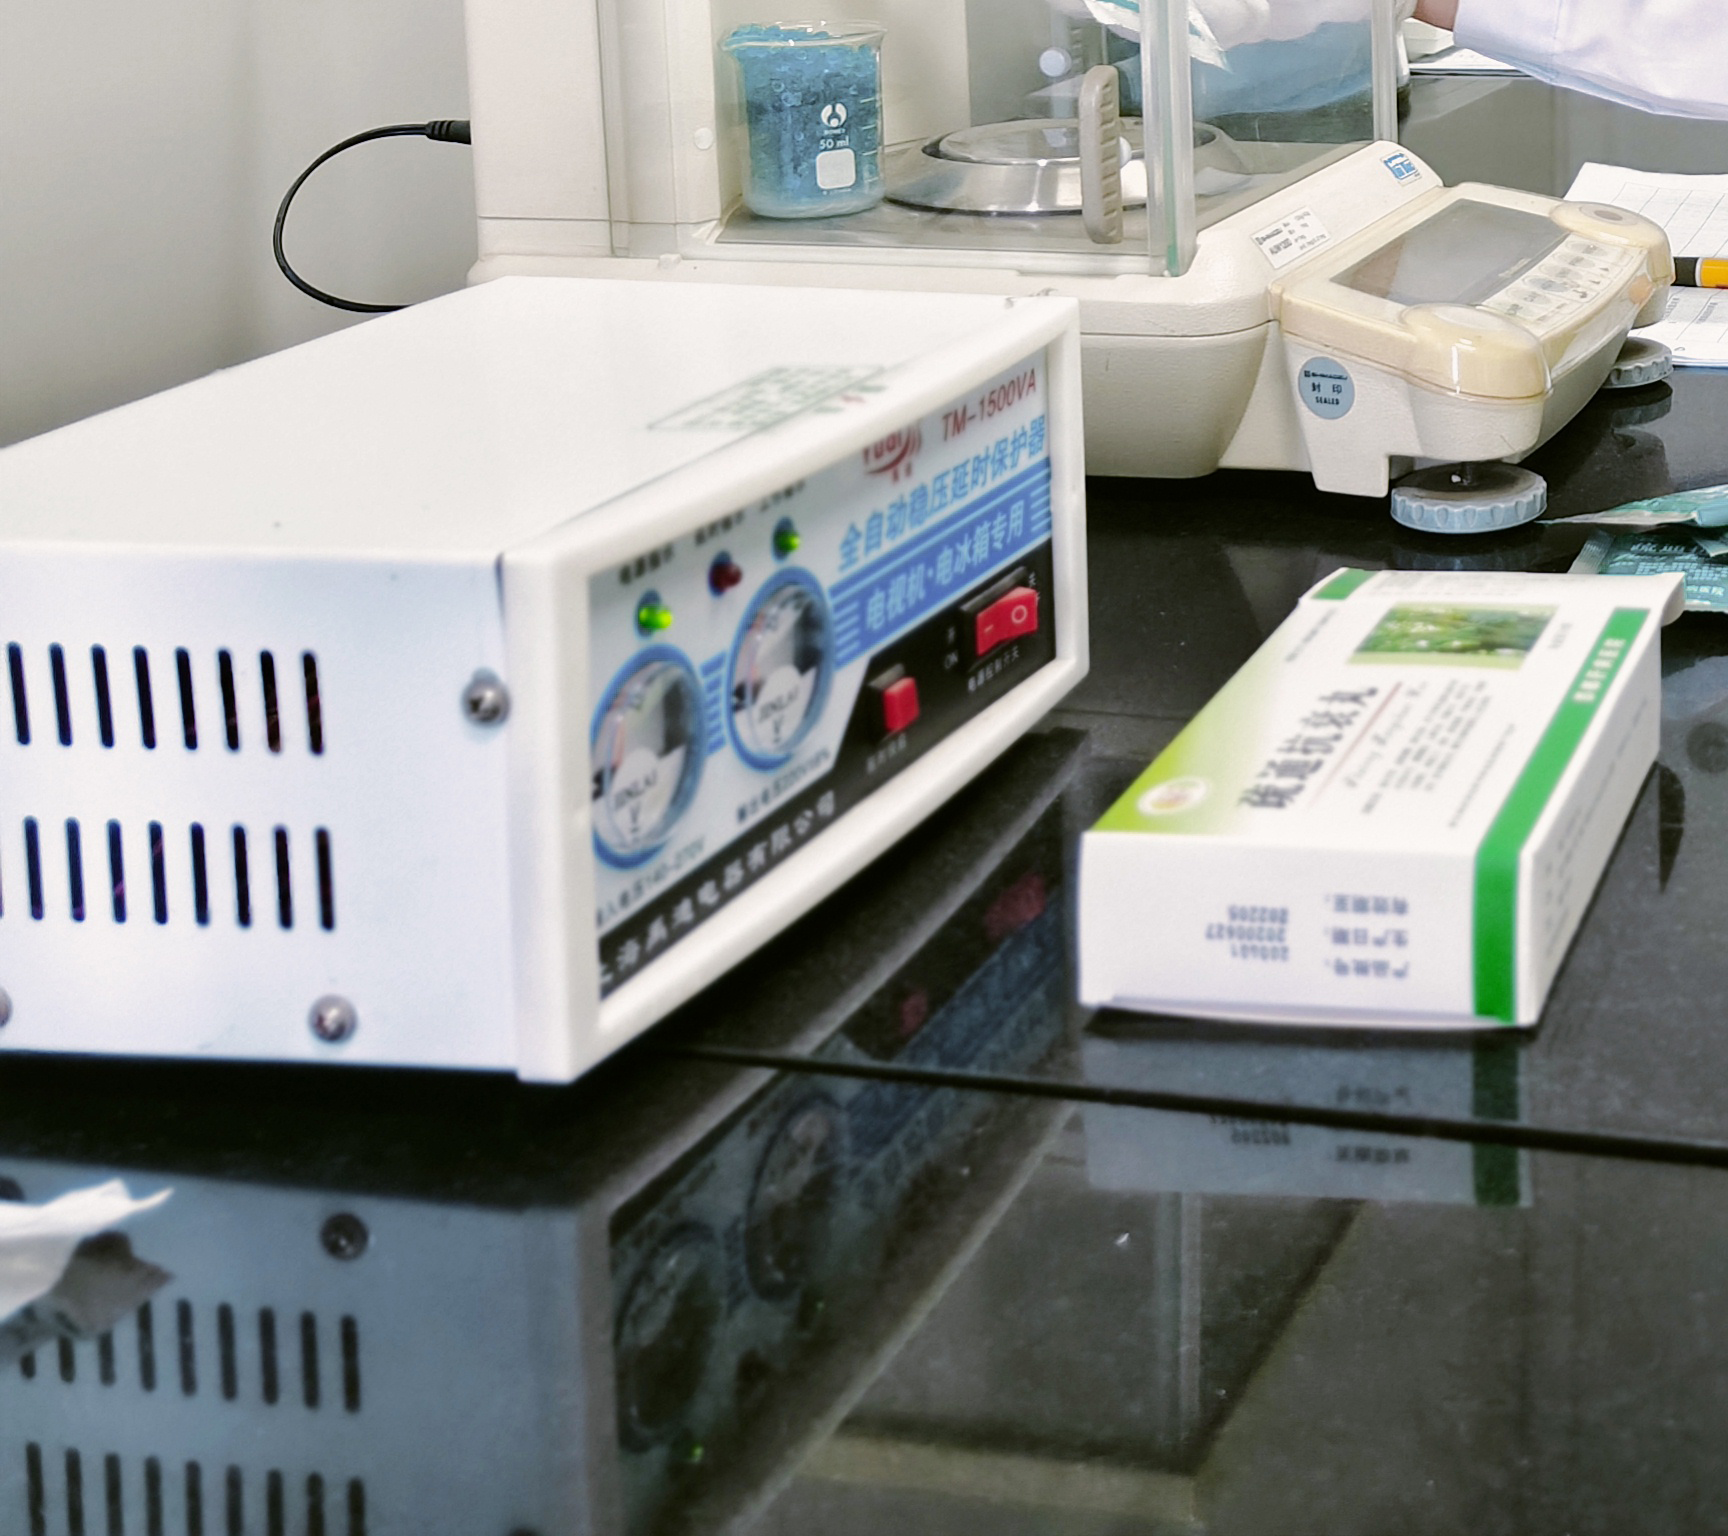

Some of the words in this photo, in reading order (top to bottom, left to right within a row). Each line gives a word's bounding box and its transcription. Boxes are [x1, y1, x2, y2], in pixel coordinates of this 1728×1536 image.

[820, 138, 834, 150] 50
[836, 135, 849, 147] ml
[942, 368, 1036, 441] TM-1500VA
[840, 414, 1046, 567] 全自动稳压延时保护器
